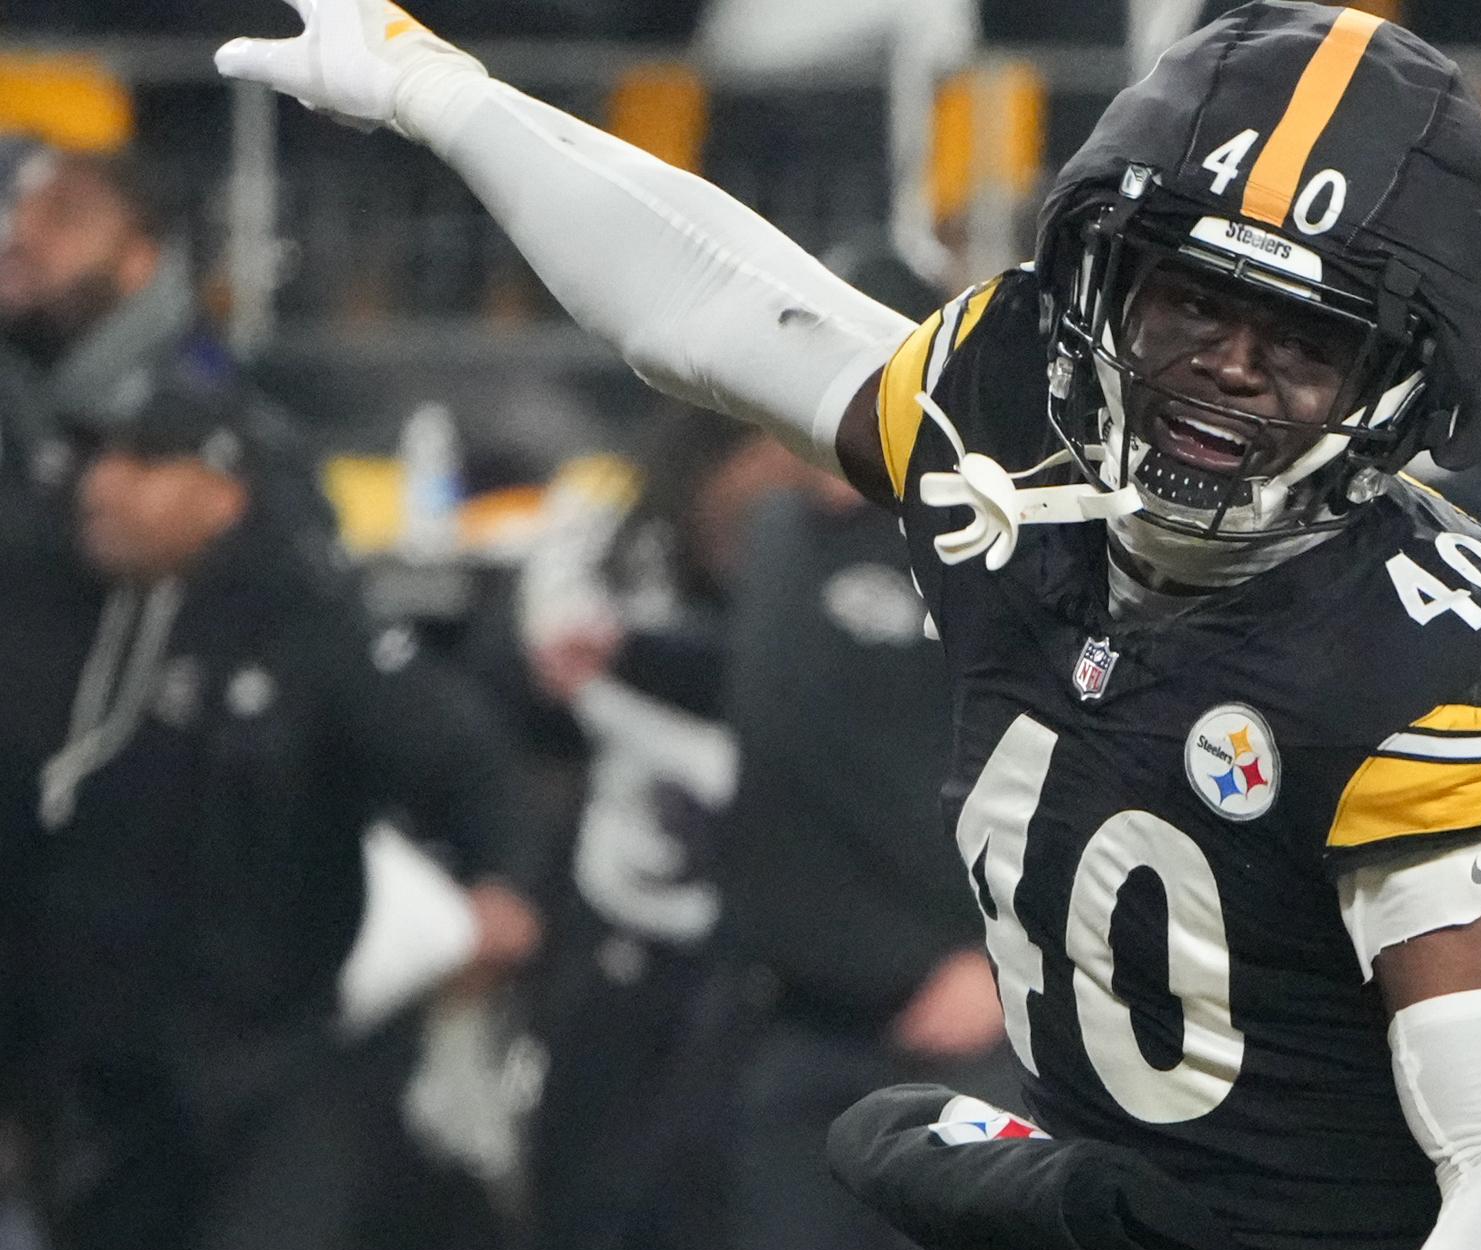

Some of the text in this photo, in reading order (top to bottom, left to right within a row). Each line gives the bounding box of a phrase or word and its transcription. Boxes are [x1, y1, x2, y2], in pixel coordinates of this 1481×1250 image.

[1225, 221, 1292, 259] Steelers
[1079, 662, 1102, 690] NFL
[1197, 734, 1233, 765] Steelers
[956, 713, 1245, 1124] 40
